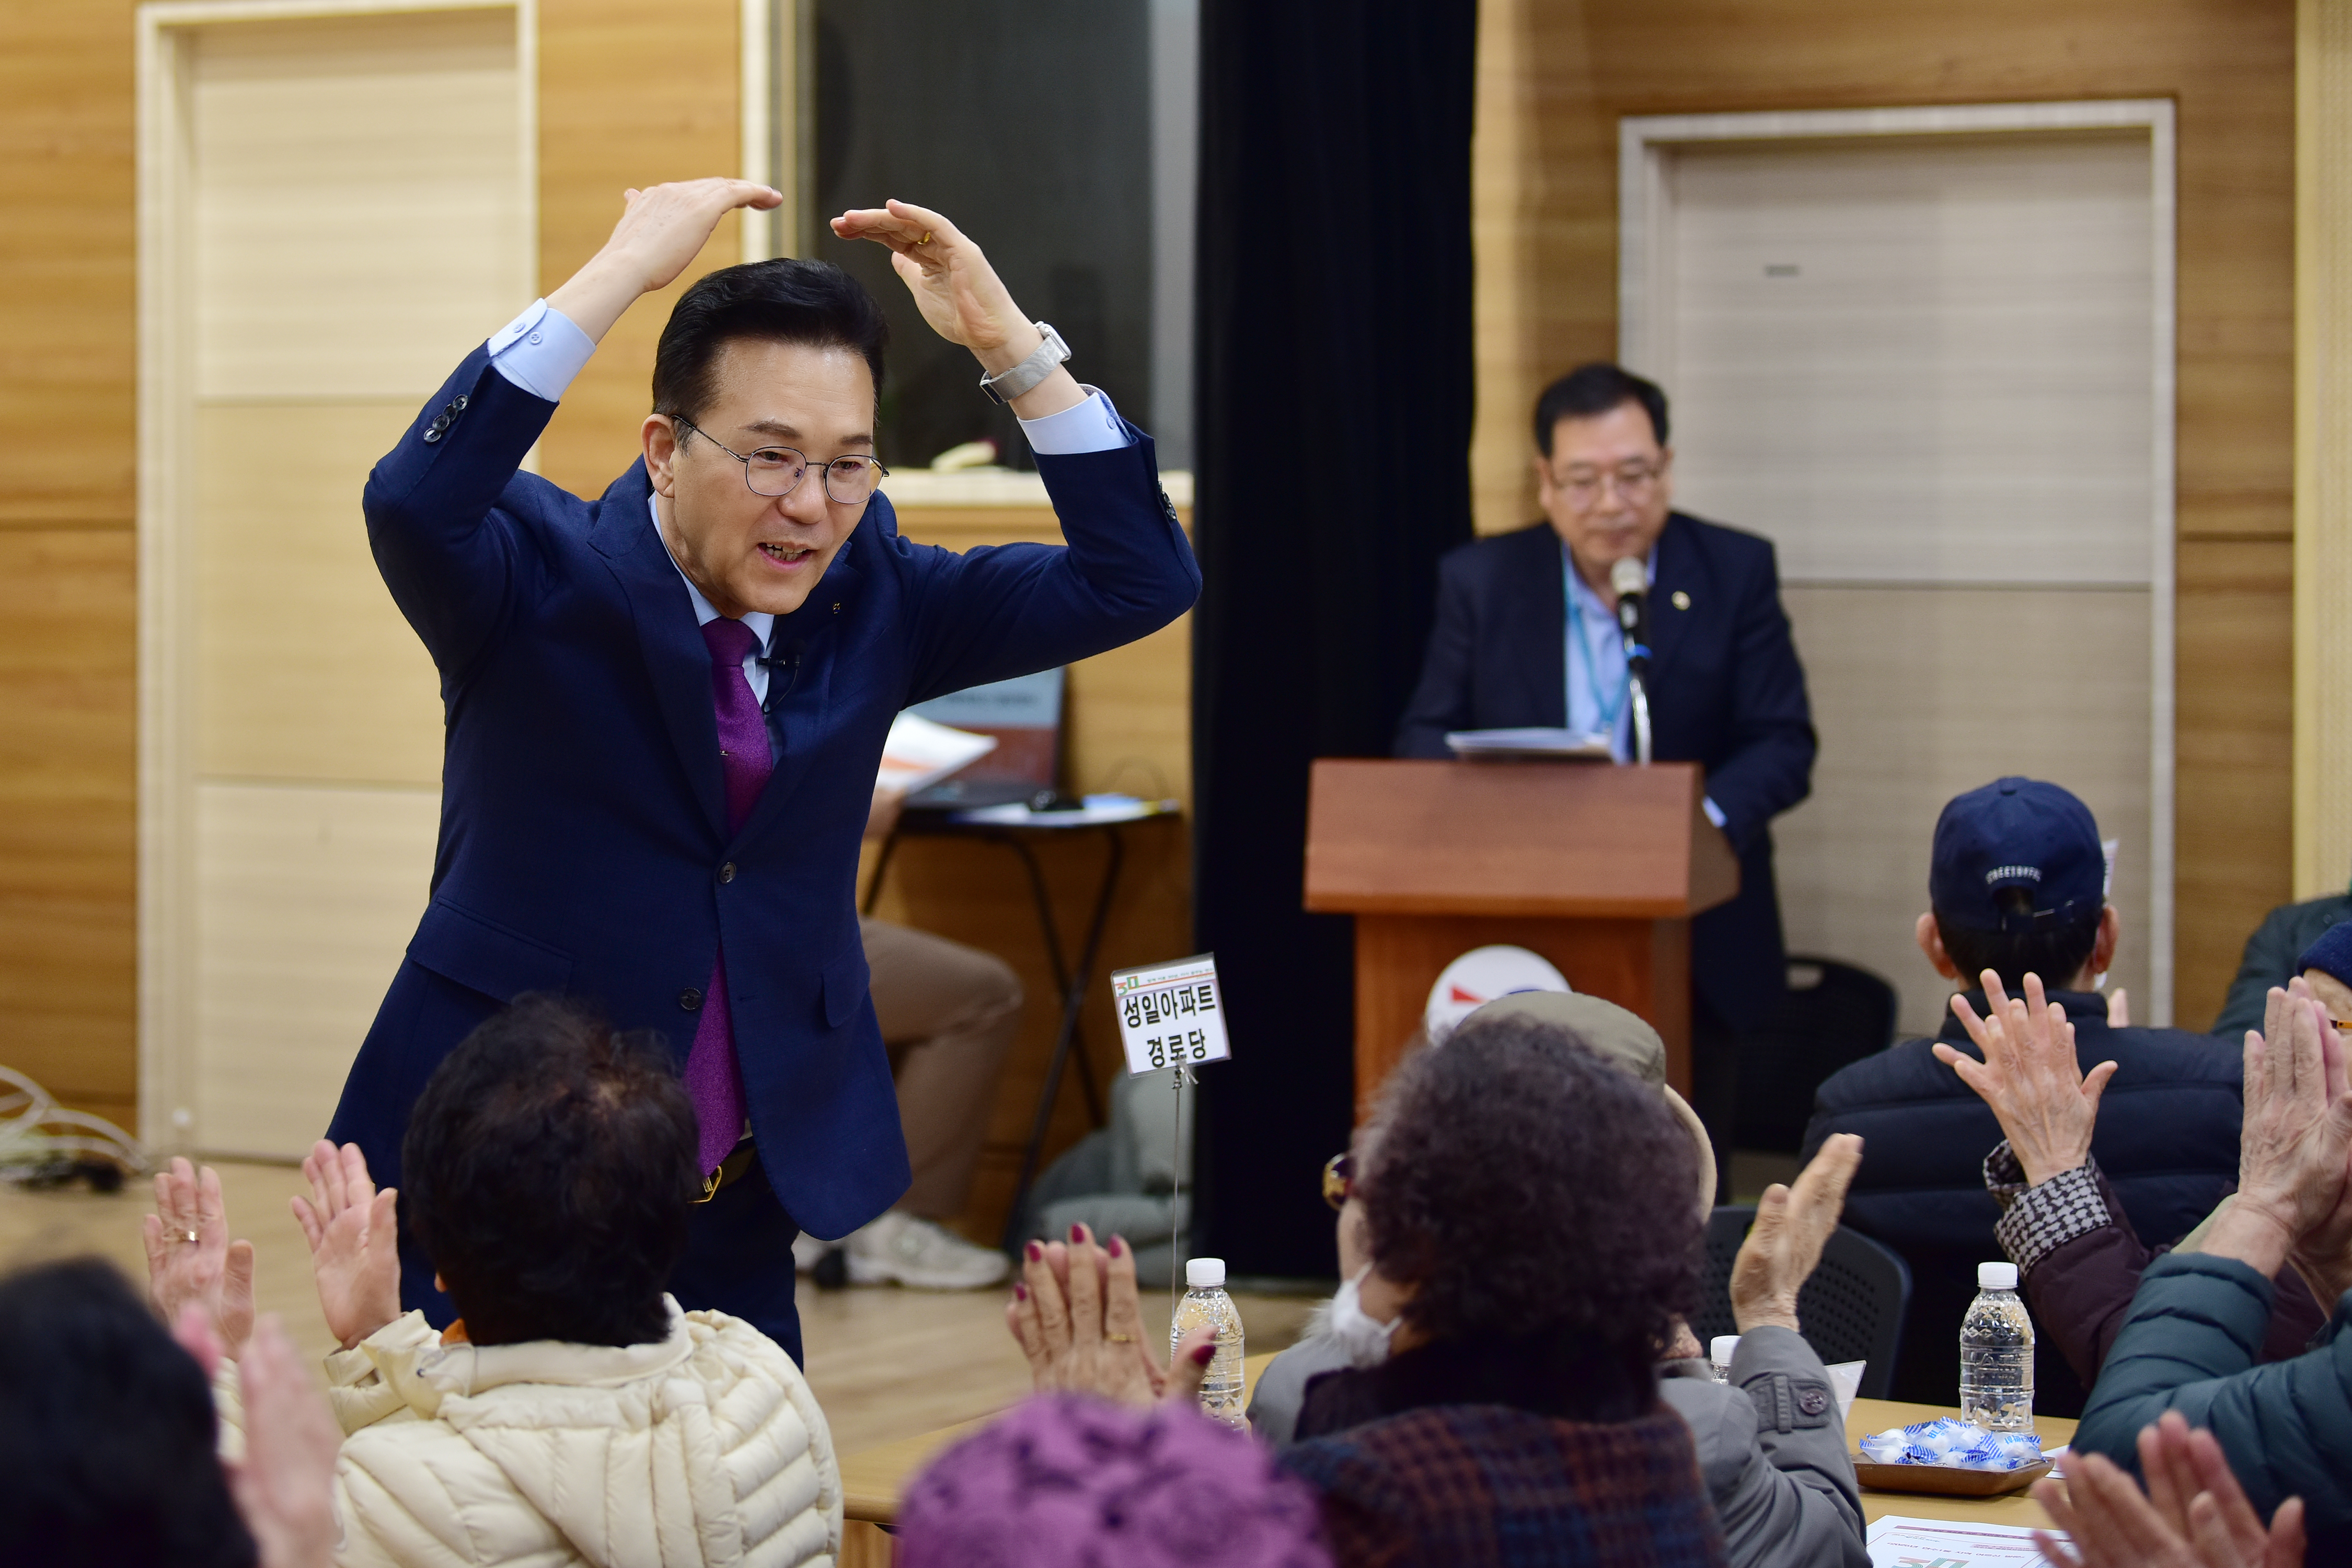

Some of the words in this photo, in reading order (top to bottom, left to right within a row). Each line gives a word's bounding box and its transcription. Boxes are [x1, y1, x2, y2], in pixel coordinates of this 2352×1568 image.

[1115, 976, 1139, 996] 30
[1124, 985, 1216, 1028] 성일아파트
[1147, 1029, 1206, 1068] 경로당
